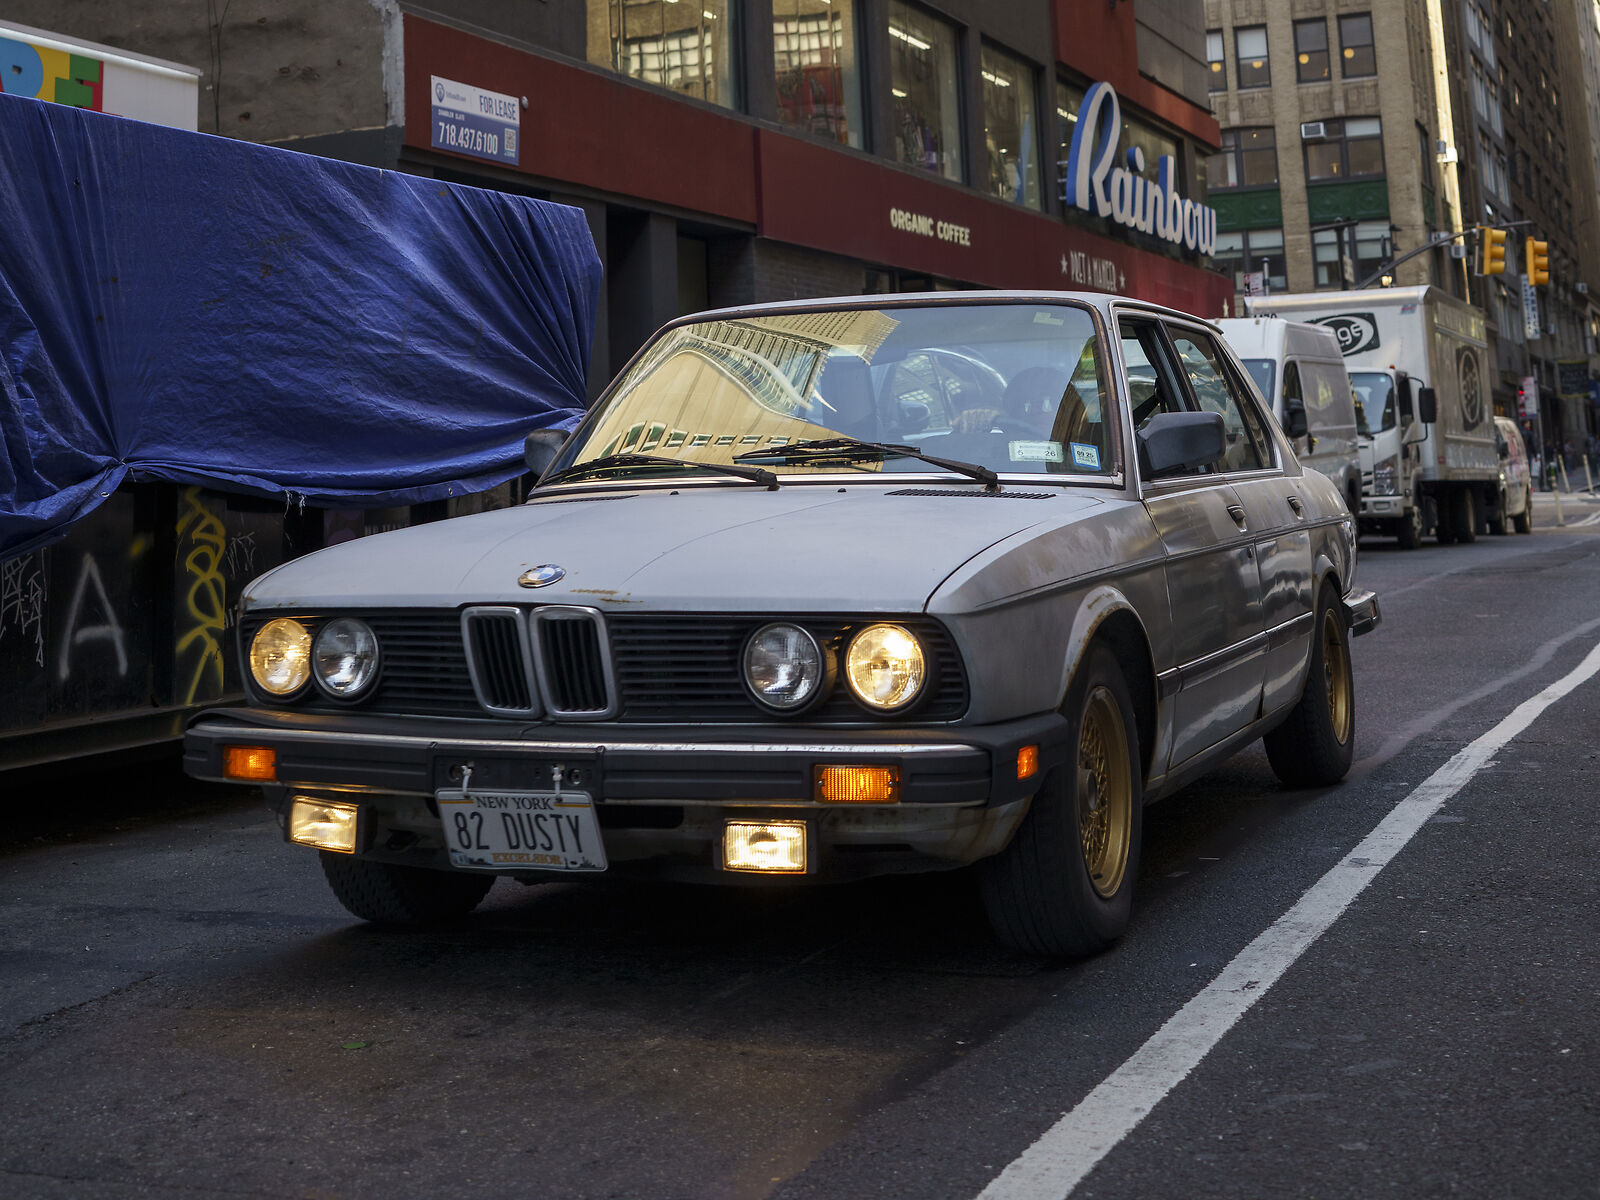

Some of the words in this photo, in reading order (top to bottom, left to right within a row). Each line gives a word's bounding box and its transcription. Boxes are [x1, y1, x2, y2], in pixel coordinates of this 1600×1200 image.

[479, 95, 494, 114] FOR
[495, 99, 516, 121] LEASE
[438, 122, 498, 155] 718.437.6100
[1066, 81, 1216, 256] Rainbow
[890, 207, 934, 237] ORGANIC
[937, 221, 971, 246] COFFEE
[57, 552, 129, 680] A
[475, 796, 508, 809] NEW
[509, 797, 554, 811] YORK
[454, 811, 490, 850] 82
[500, 812, 583, 853] DUSTY
[491, 853, 563, 865] EXCELSIOR
